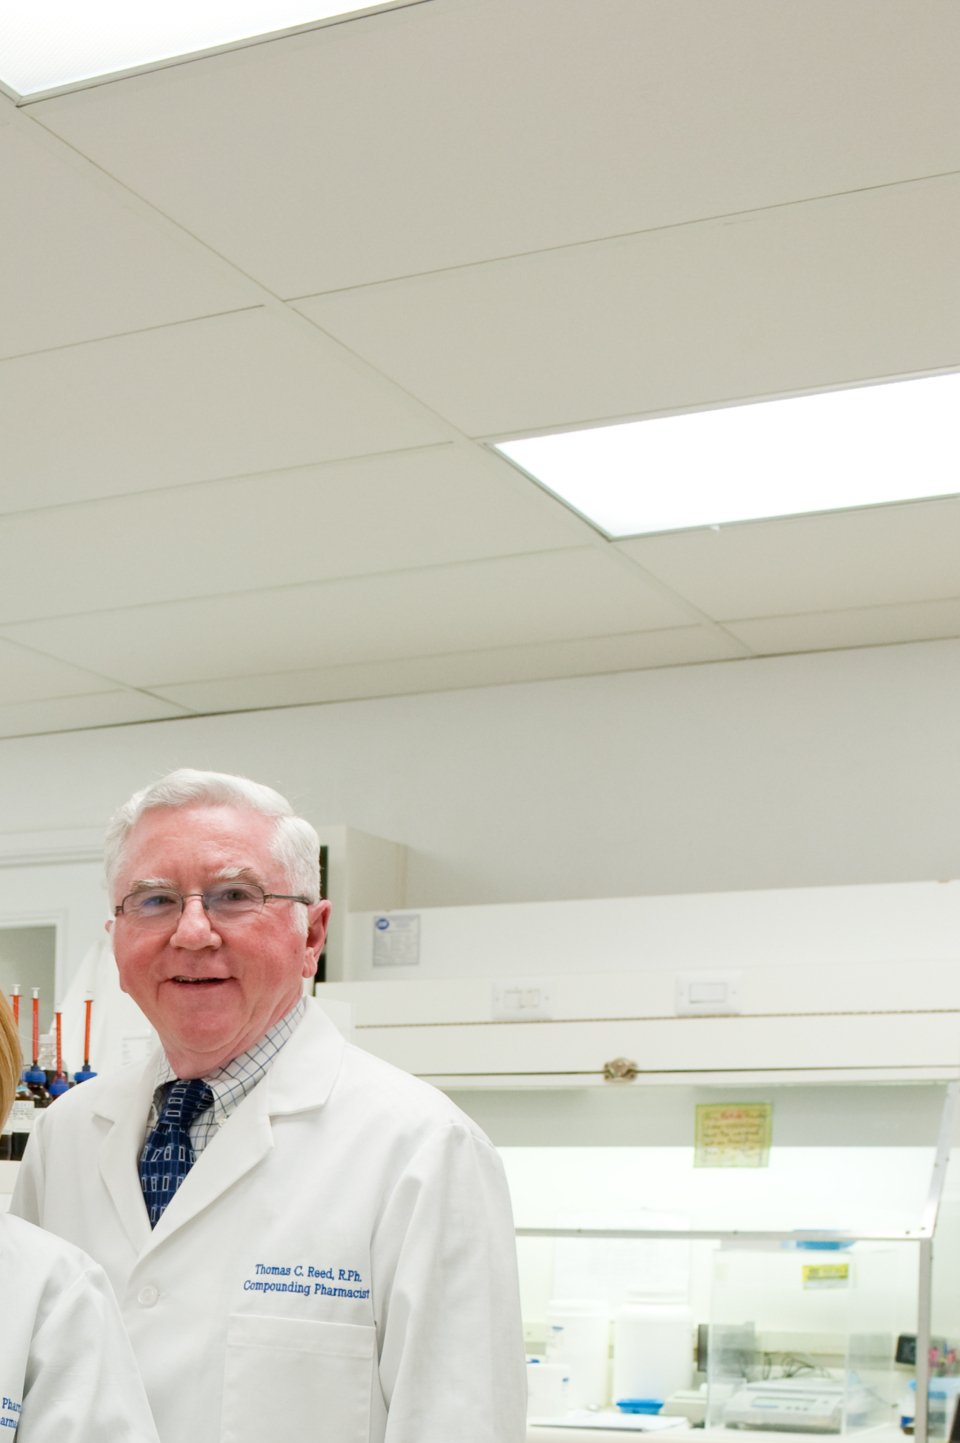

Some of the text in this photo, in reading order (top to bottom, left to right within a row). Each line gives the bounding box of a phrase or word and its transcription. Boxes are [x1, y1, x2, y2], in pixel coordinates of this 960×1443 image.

[255, 1263, 291, 1276] Thomas
[293, 1265, 304, 1277] C.
[307, 1266, 335, 1280] Reed,
[243, 1279, 371, 1299] Compounding Pharmacist
